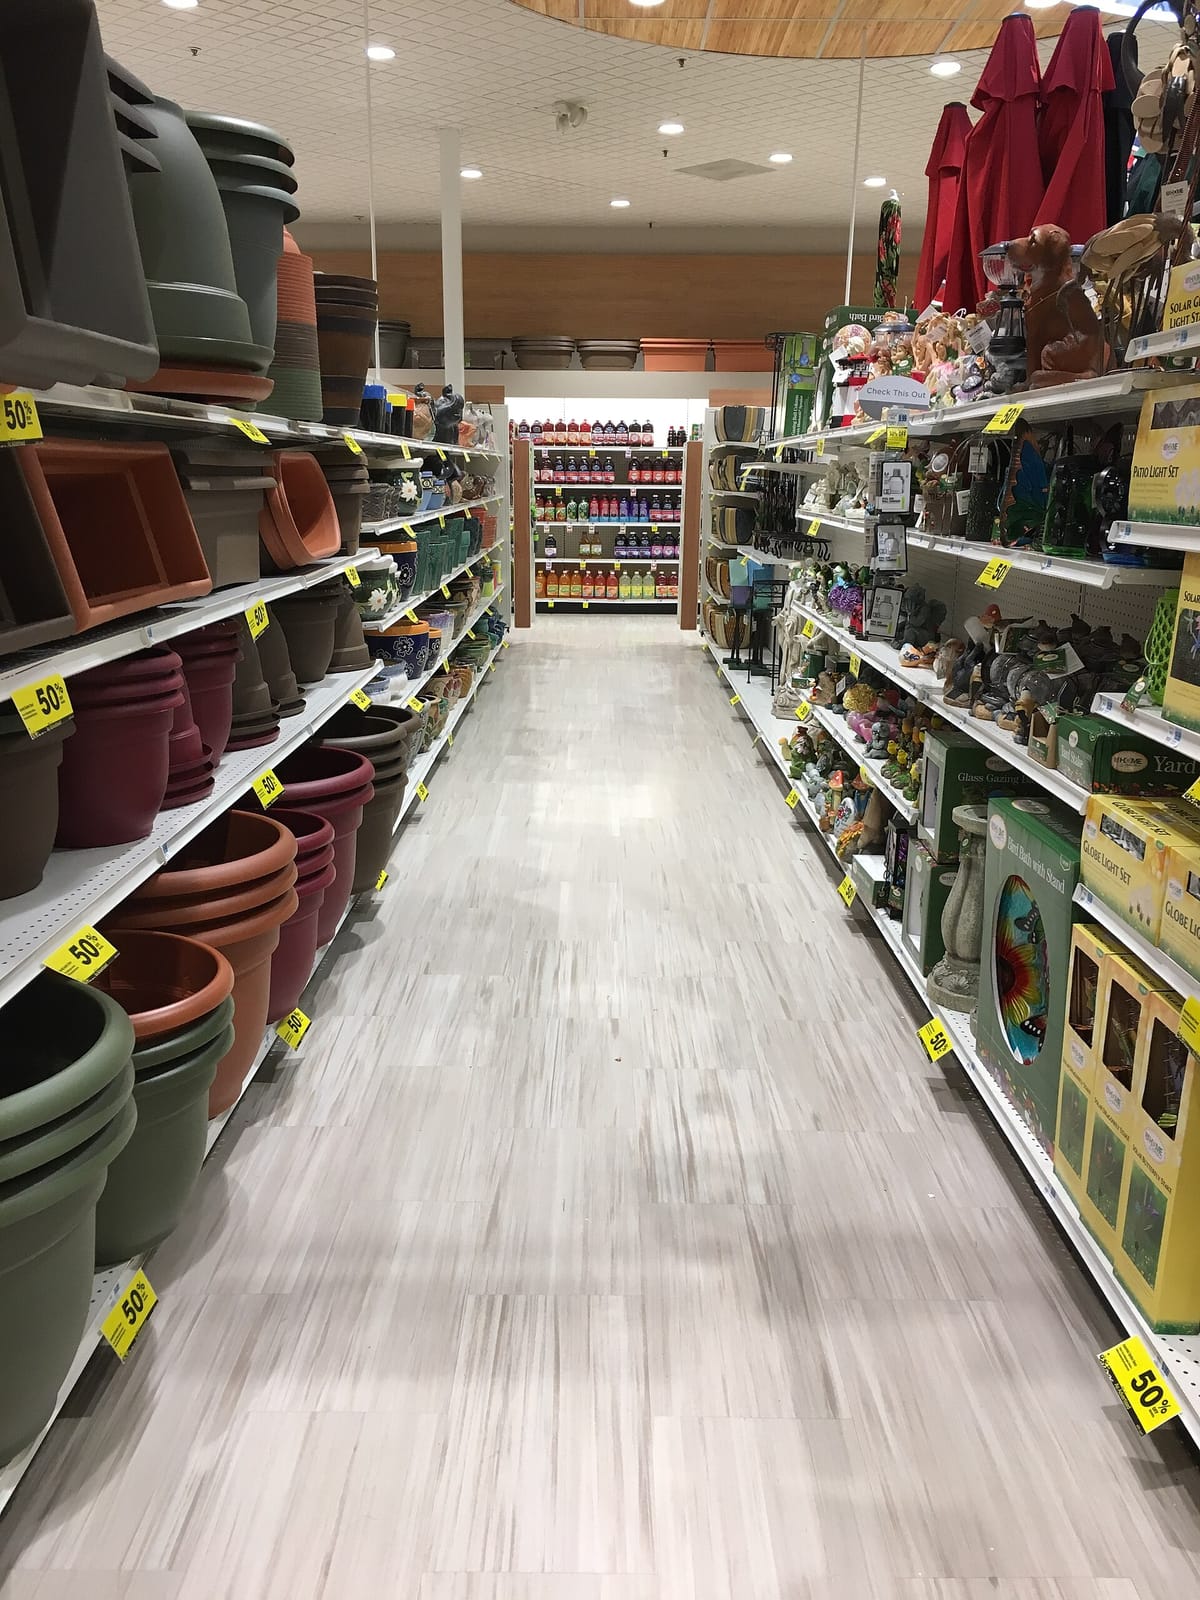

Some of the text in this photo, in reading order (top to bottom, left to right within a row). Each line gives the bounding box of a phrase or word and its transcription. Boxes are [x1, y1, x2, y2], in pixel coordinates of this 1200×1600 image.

[849, 313, 867, 322] Bath
[1170, 299, 1192, 315] SOLAR
[1169, 315, 1191, 329] LIGHT
[866, 387, 927, 399] Check This Out
[1133, 465, 1179, 478] PATIO LIGHT SET
[36, 682, 64, 715] 50%
[957, 772, 984, 782] Glass
[1153, 755, 1197, 775] Yard
[1008, 835, 1065, 894] Bird Bath with Stand
[1083, 840, 1131, 886] GLOBE LIGHT SET
[1165, 901, 1189, 930] GLOBE
[68, 933, 98, 965] 50%
[122, 1281, 146, 1325] 50%
[1131, 1370, 1171, 1414] 50%
